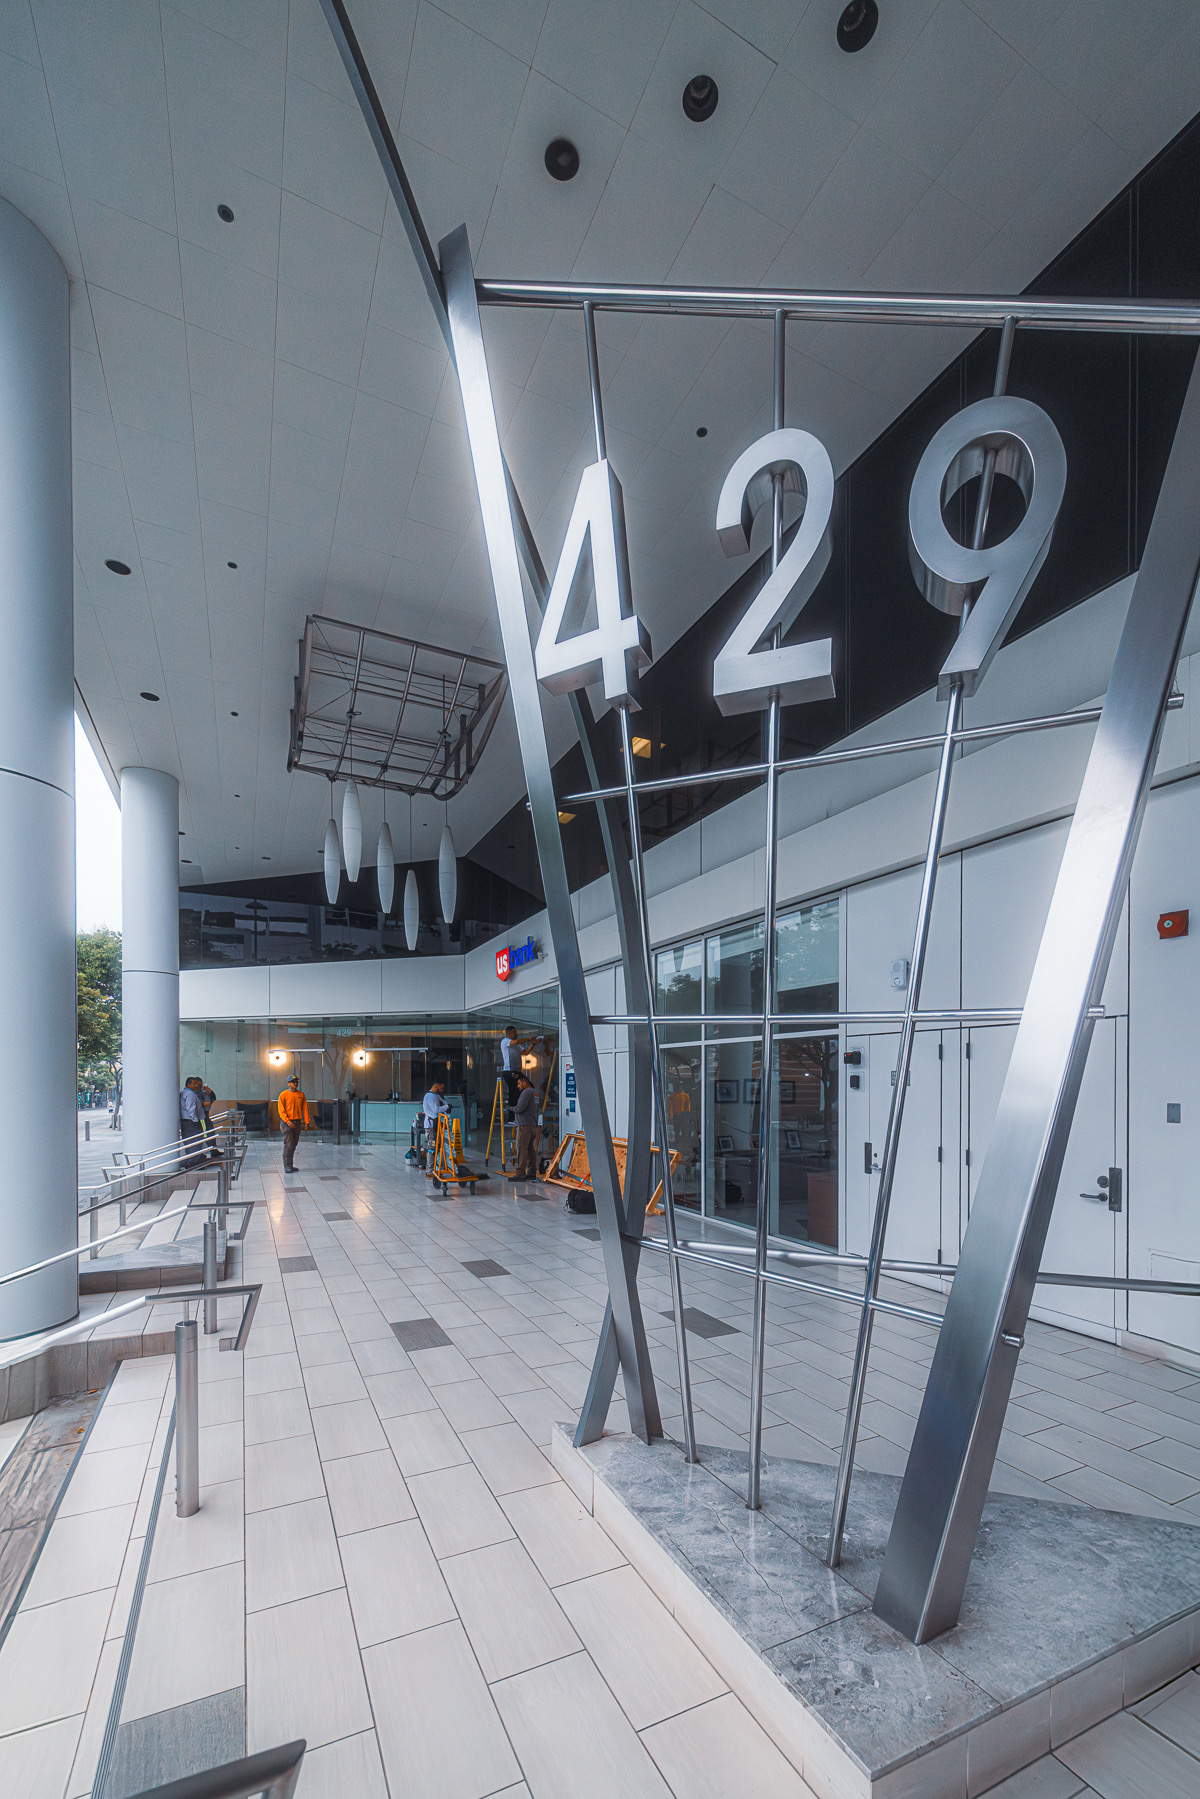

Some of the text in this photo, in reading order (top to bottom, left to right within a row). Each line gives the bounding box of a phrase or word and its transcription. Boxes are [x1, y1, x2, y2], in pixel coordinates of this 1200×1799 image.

[535, 396, 1068, 703] 429
[509, 935, 535, 970] bank
[336, 1028, 352, 1037] 429
